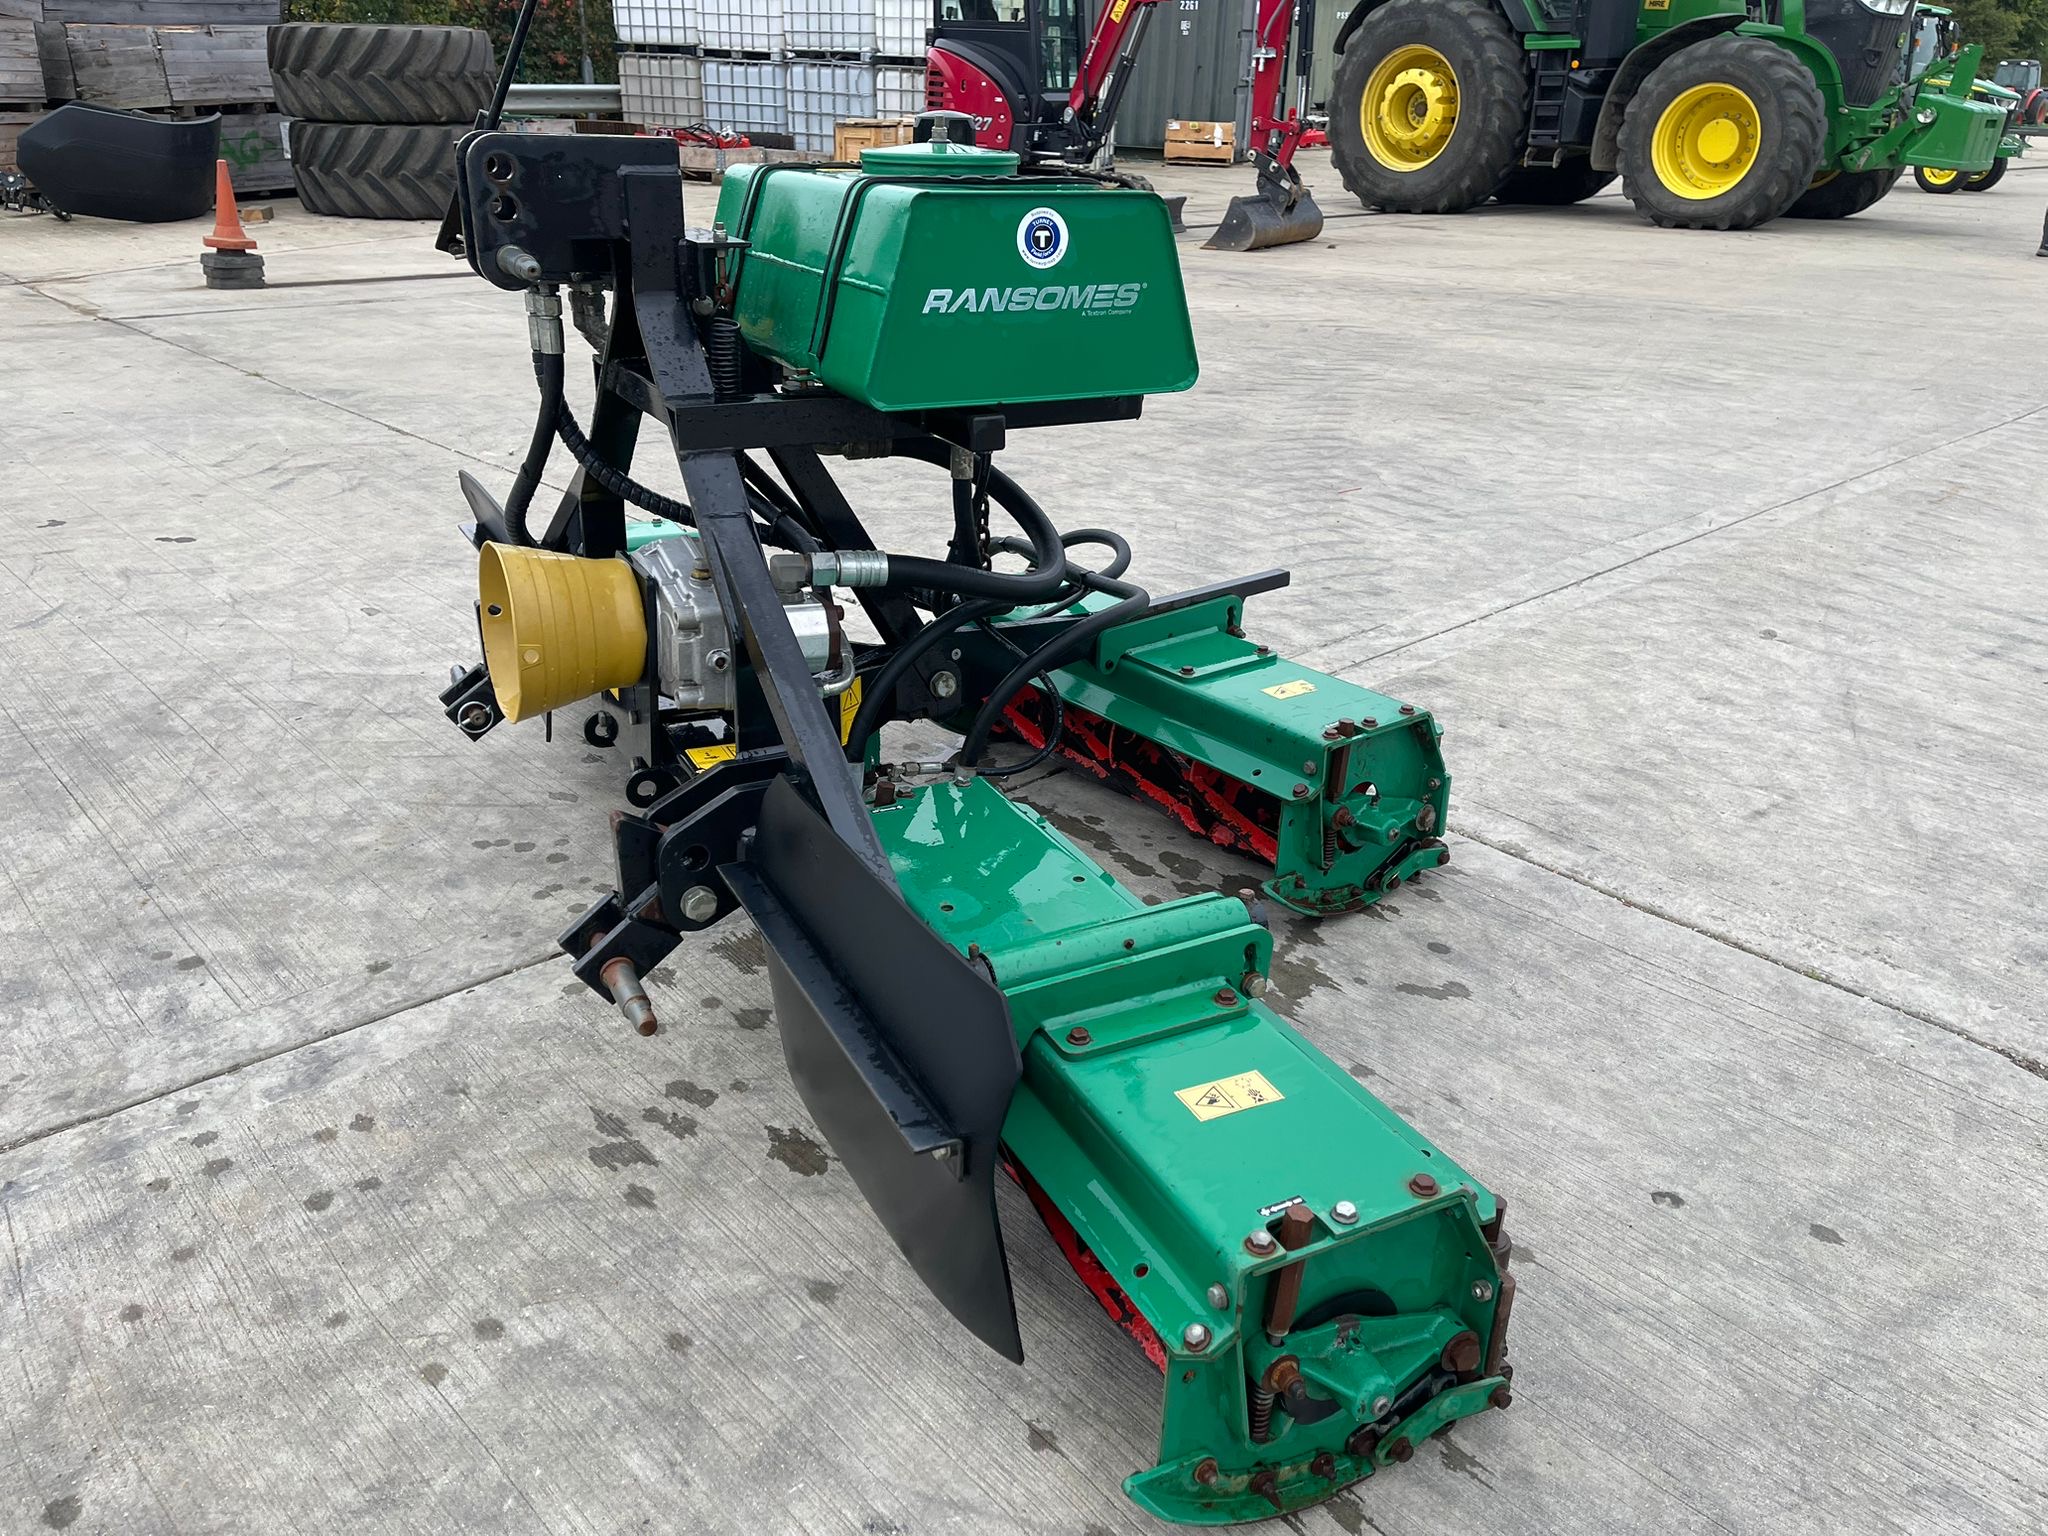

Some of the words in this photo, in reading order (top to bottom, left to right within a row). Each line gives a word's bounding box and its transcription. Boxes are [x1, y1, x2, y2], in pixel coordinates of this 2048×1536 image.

[1180, 0, 1199, 10] 2261
[1032, 218, 1054, 226] TURNEY
[1034, 230, 1051, 248] T
[922, 283, 1141, 314] RANSOMES
